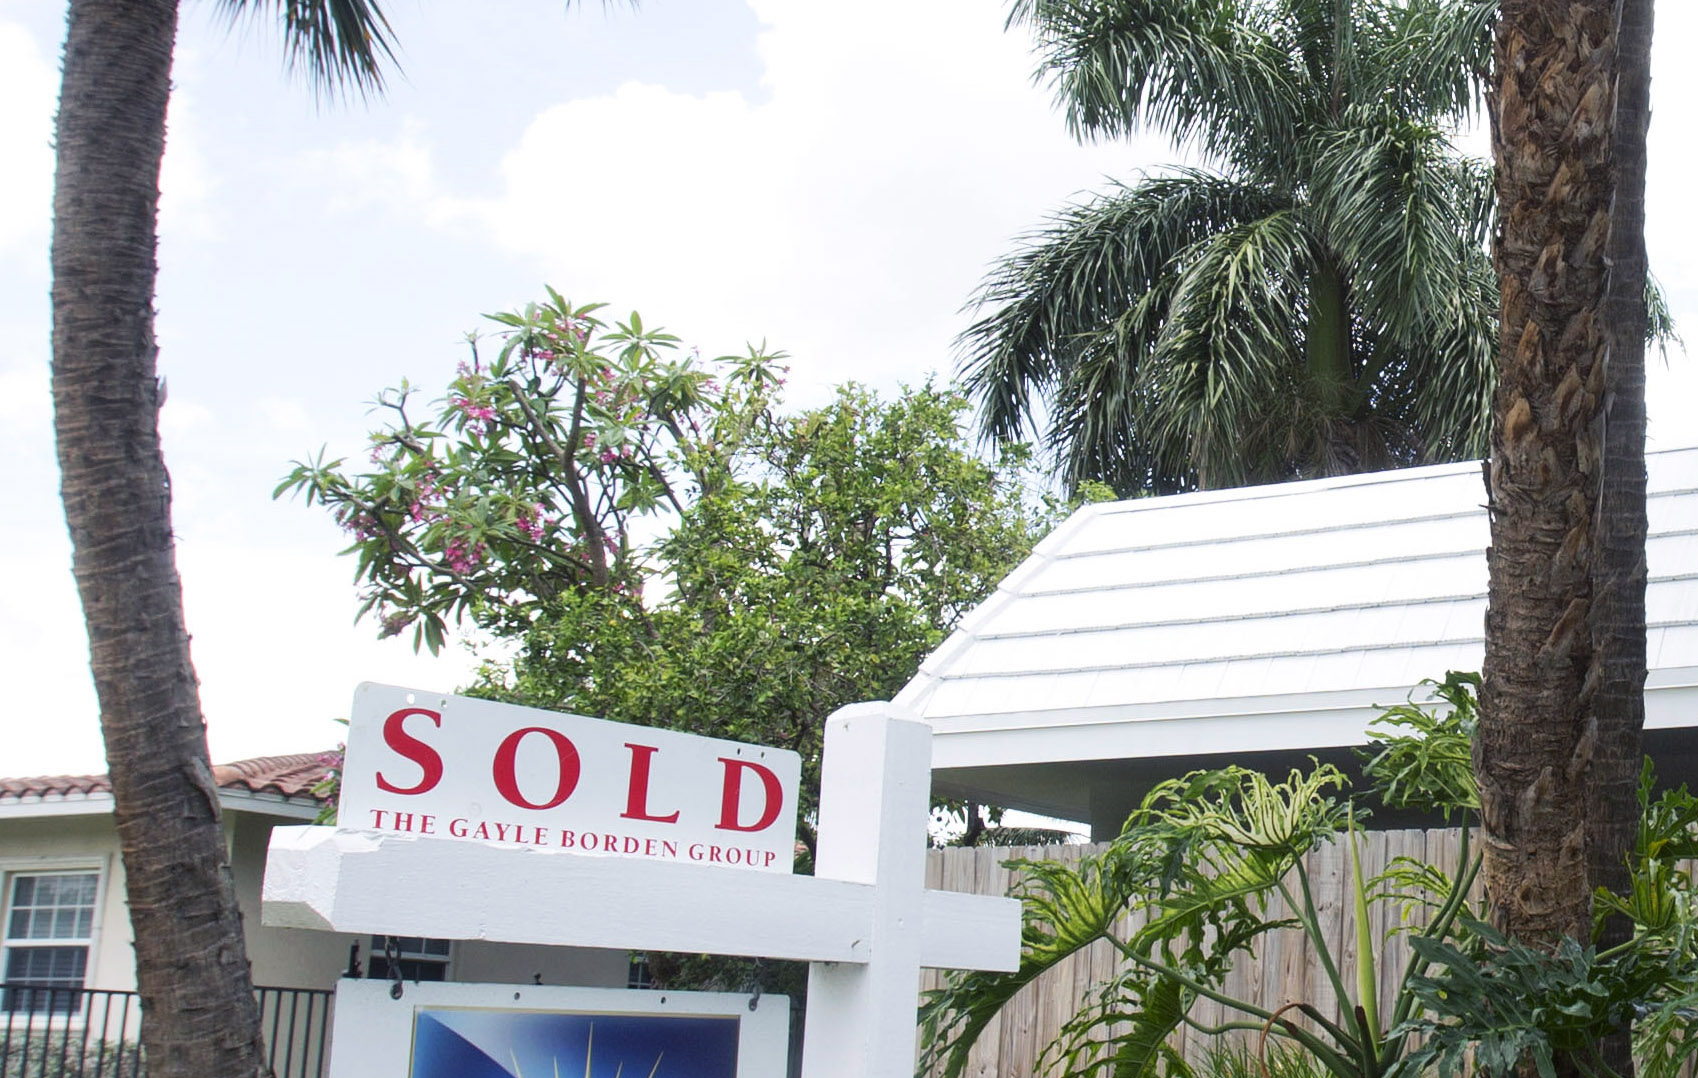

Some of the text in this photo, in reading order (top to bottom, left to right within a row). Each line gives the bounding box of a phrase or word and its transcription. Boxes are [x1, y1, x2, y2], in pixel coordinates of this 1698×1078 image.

[375, 707, 784, 833] SOLD
[370, 809, 776, 868] THE GAYLE BORDEN GROUP
